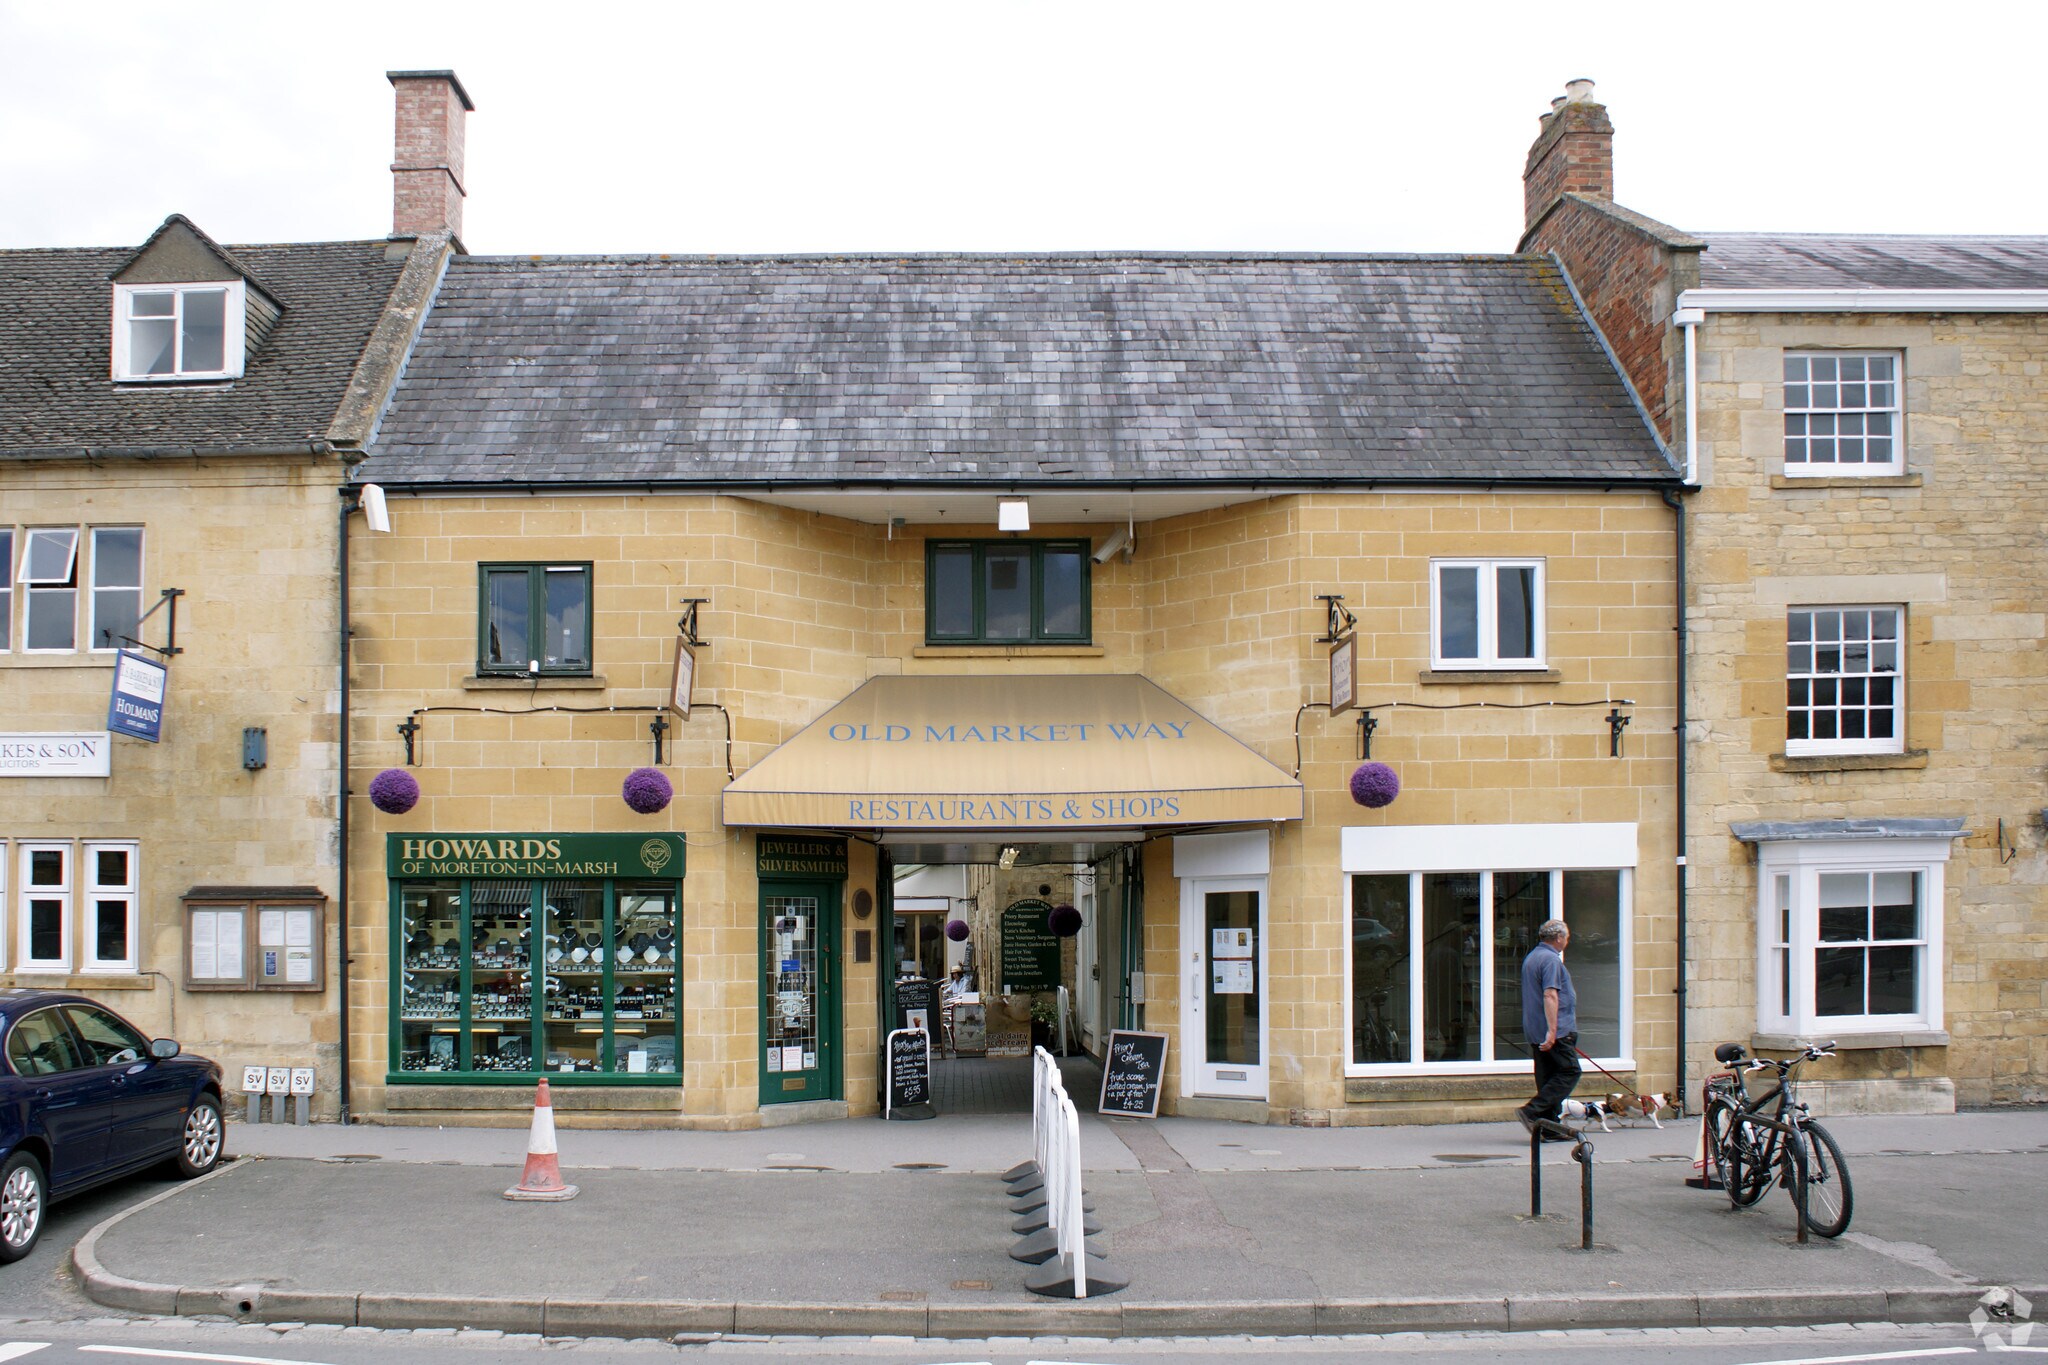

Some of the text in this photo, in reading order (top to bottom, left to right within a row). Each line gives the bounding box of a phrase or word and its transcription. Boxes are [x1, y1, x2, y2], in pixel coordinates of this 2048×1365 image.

[116, 697, 159, 722] HOLMANS
[829, 721, 1191, 742] OLD MARKET WAY
[39, 744, 53, 758] &
[58, 741, 96, 758] SON
[850, 797, 1180, 821] RESTAURANTS & SHOPS
[402, 839, 562, 860] HOWARDS
[760, 841, 845, 857] JEWELLERS &
[402, 861, 618, 875] OF MORETON-IN-MARSH
[759, 859, 846, 873] SILVERSMITHS
[1006, 1032, 1028, 1040] dairy
[1113, 1042, 1135, 1054] Priory
[1121, 1053, 1145, 1062] Cream
[1136, 1060, 1150, 1069] Tea
[247, 1074, 262, 1084] SV
[271, 1075, 286, 1085] SV
[295, 1076, 310, 1085] SV
[1109, 1070, 1125, 1083] fruit
[1107, 1081, 1126, 1091] clotted
[1143, 1083, 1157, 1093] jam
[1116, 1091, 1125, 1101] pot
[1127, 1090, 1133, 1099] of
